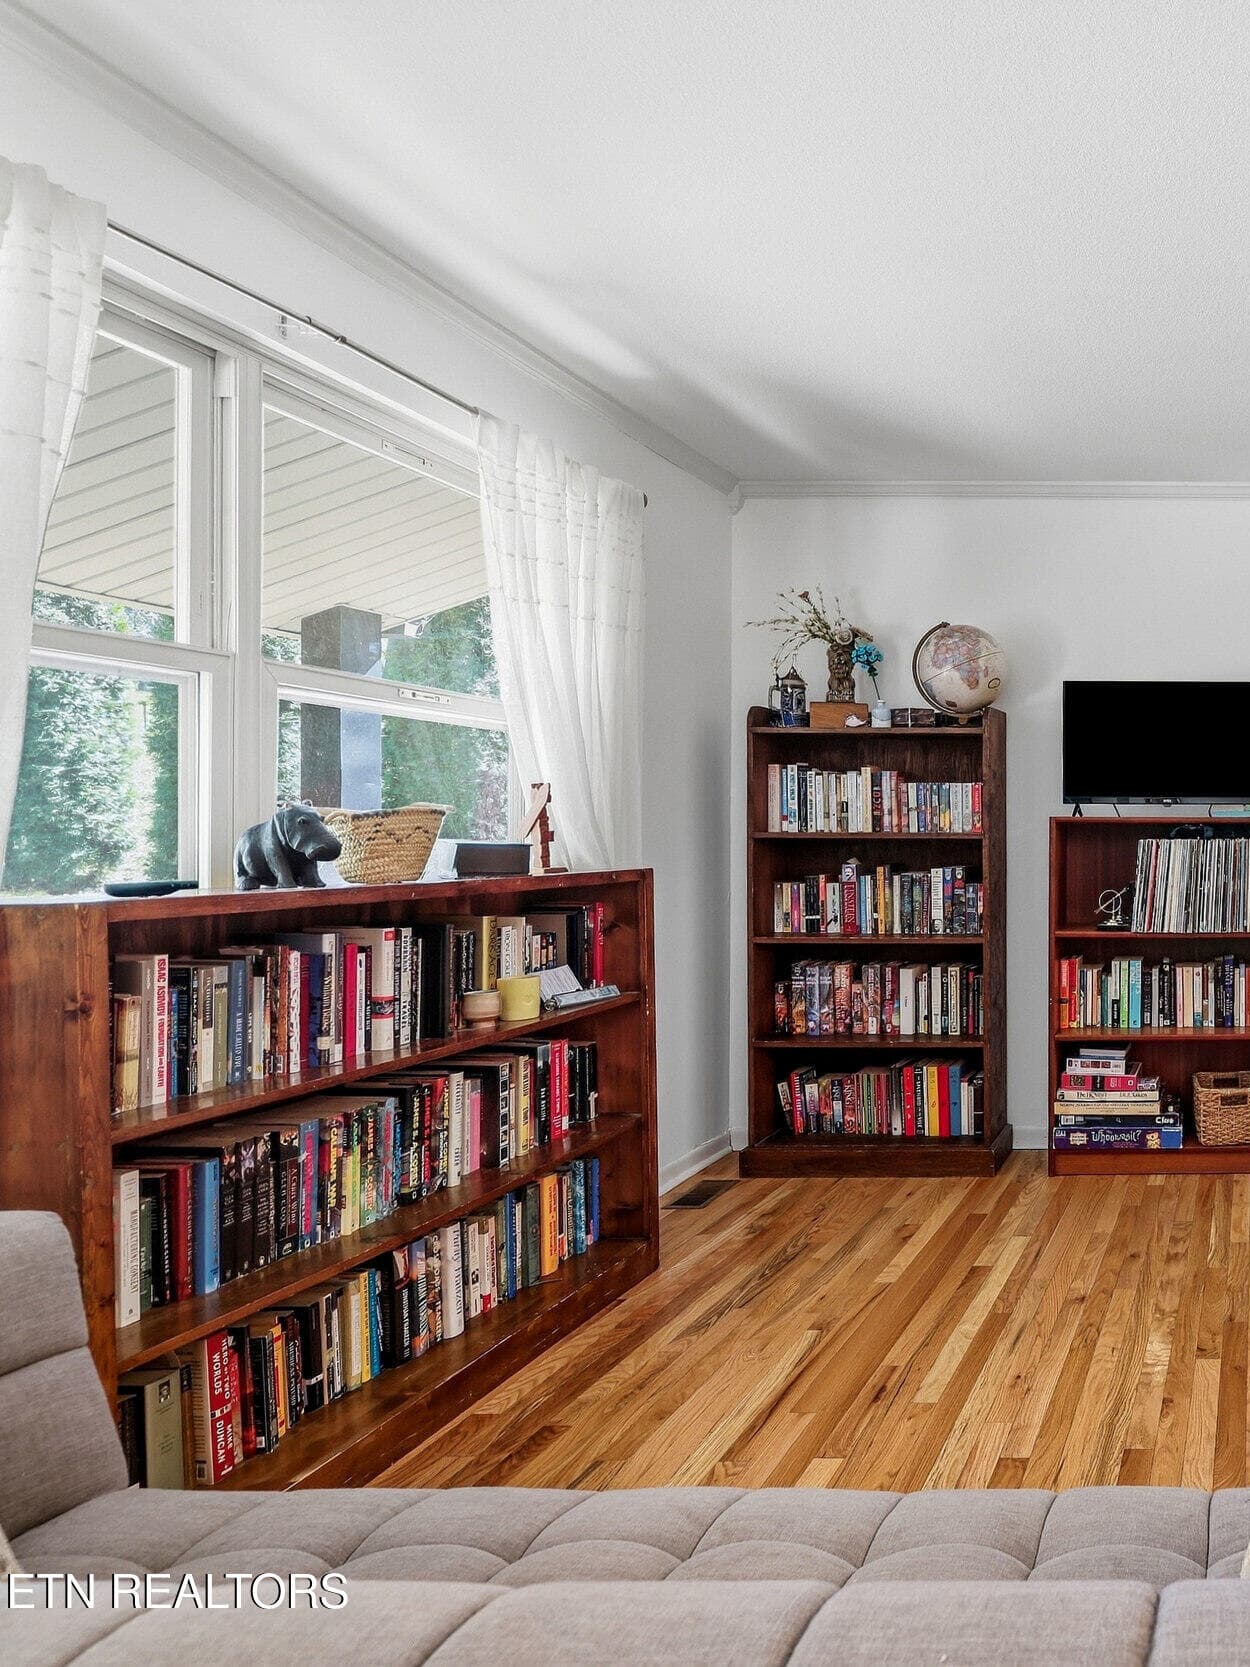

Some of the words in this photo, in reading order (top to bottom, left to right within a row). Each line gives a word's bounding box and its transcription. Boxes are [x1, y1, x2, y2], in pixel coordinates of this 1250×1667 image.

[157, 959, 166, 983] ISAAC
[156, 985, 166, 1016] ASIMOV
[1155, 1116, 1175, 1124] Clue
[411, 1152, 419, 1186] COREY
[451, 1228, 461, 1262] Purity
[432, 1235, 441, 1292] CROSSROADS
[454, 1267, 464, 1315] Franzen
[221, 1337, 230, 1365] HERO
[212, 1351, 222, 1395] WORLDS
[223, 1375, 231, 1399] TWO
[216, 1419, 226, 1463] DUNCAN
[226, 1423, 234, 1449] MIKE
